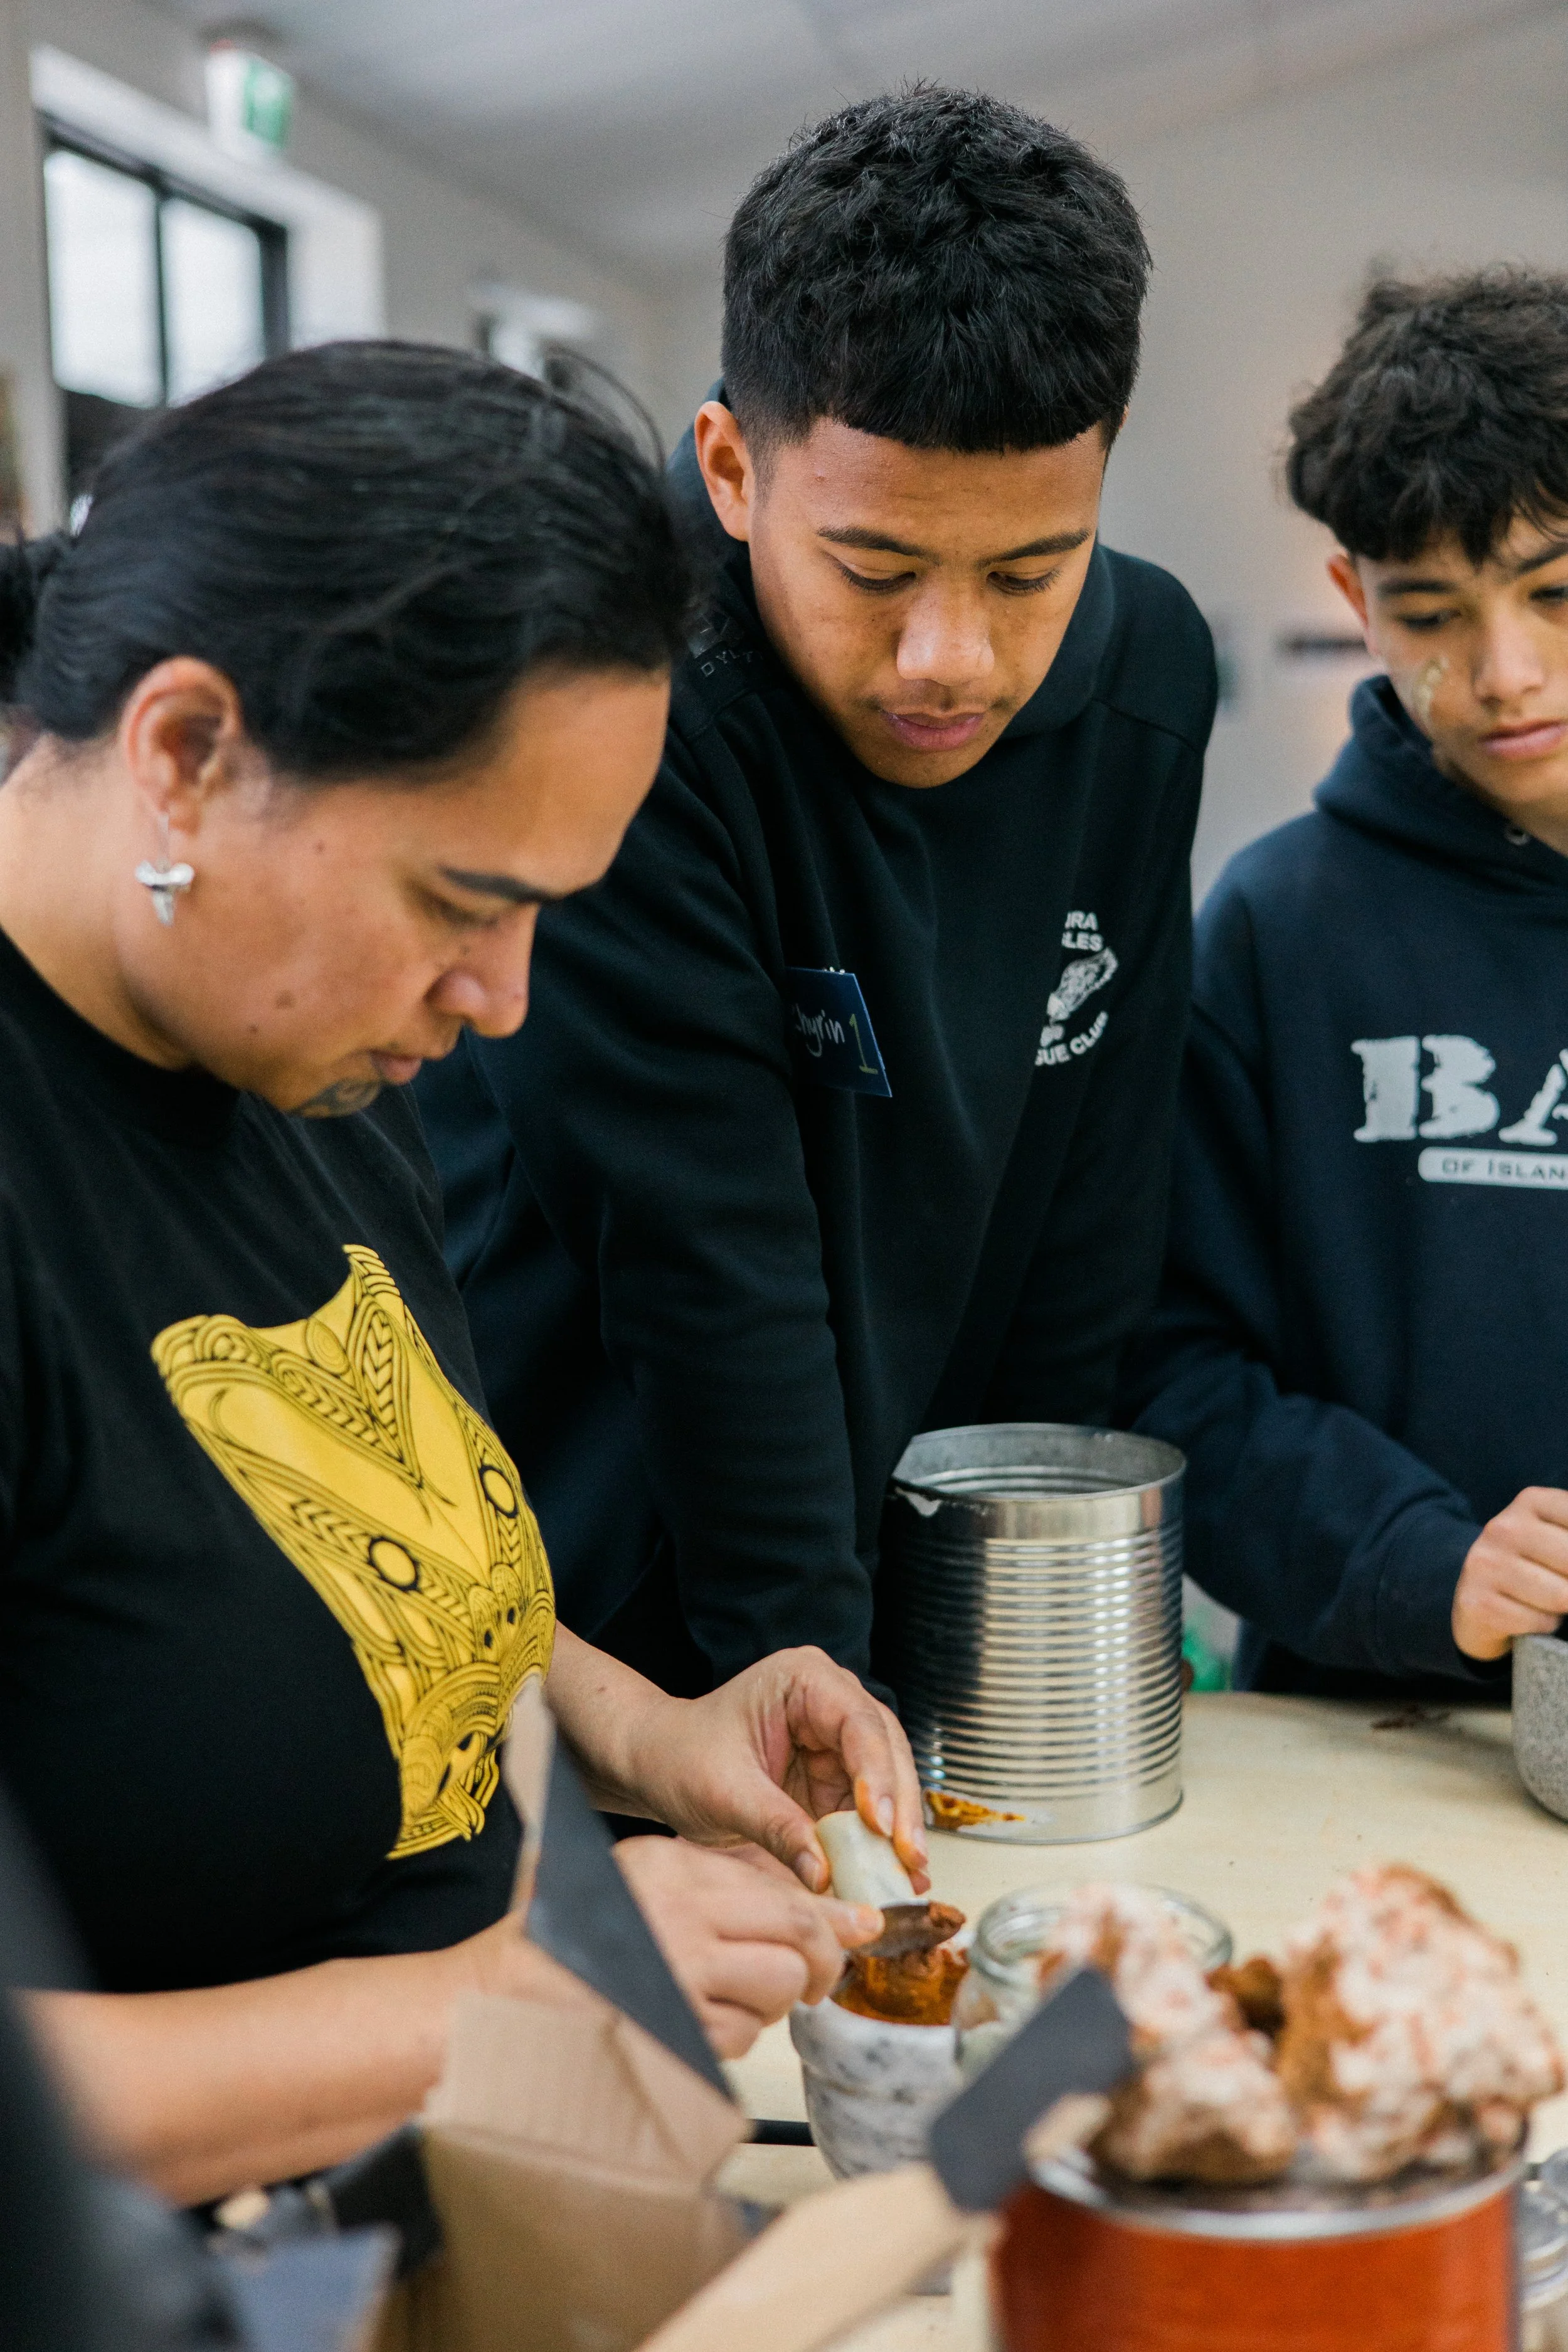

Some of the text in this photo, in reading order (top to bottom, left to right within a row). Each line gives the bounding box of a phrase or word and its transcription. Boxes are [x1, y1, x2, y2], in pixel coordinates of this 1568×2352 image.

[1061, 931, 1103, 951] LES
[849, 1014, 879, 1074] 1
[1442, 1158, 1475, 1173] OF
